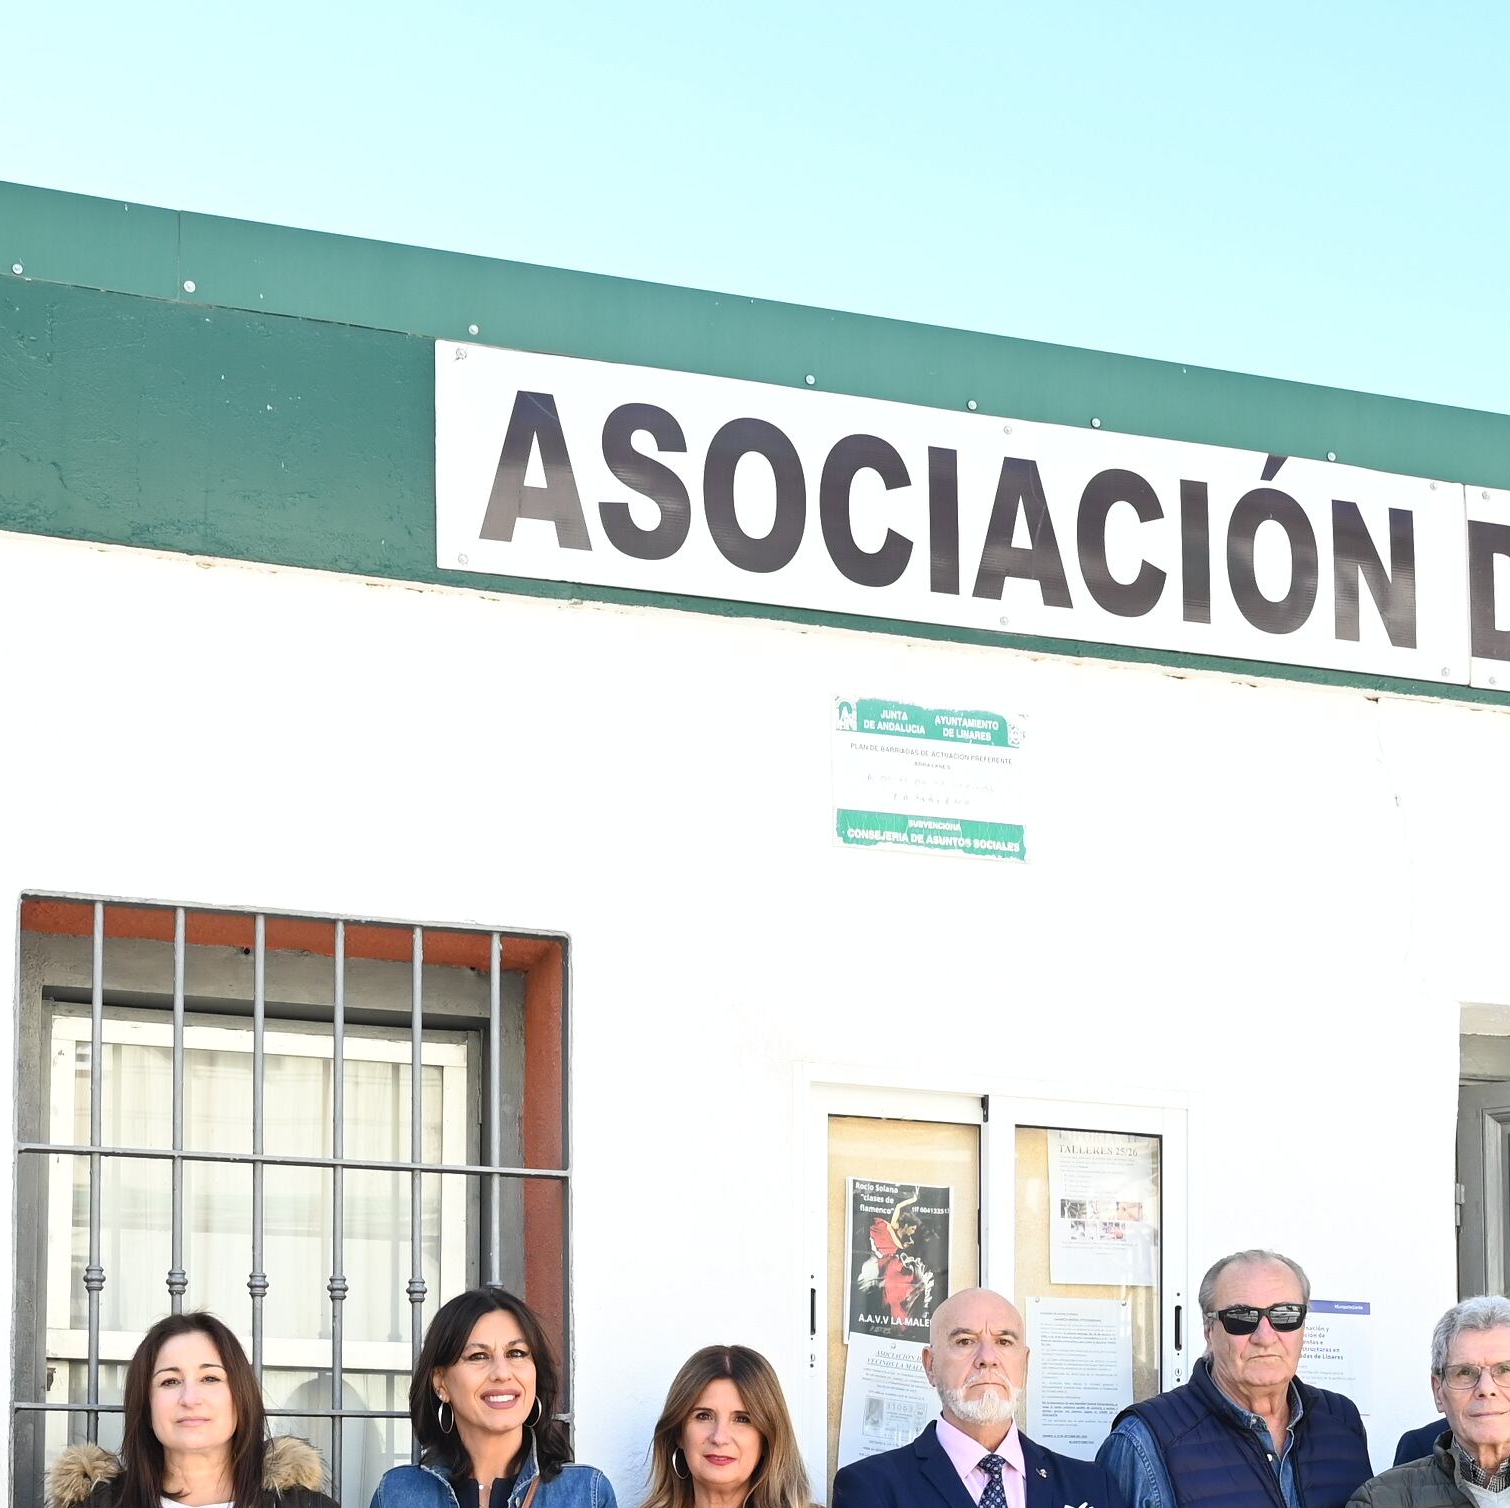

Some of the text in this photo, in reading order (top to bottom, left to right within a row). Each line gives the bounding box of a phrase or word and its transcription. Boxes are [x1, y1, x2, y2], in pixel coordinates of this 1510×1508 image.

[478, 390, 1417, 649] ASOCIACIÓN
[880, 709, 909, 721] JUNTA
[863, 719, 926, 735] DE ANDALUCIA
[934, 714, 999, 731] AYUNTAMIENTO
[942, 727, 992, 742] DE LINARES
[850, 741, 868, 751] PLAN
[868, 743, 879, 752] DE
[880, 745, 919, 757] BARRIADAS
[920, 749, 930, 758] DE
[970, 754, 1013, 766] PREFERENTE
[907, 819, 962, 832] SUBVENCIONA
[910, 833, 925, 844] DE
[925, 835, 972, 848] ASUNTOS
[973, 839, 1021, 853] SOCIALES
[1059, 1144, 1113, 1155] TALLERES
[875, 1184, 899, 1193] Solana
[885, 1195, 895, 1204] de
[891, 1316, 903, 1326] LA
[904, 1317, 931, 1328] MALE
